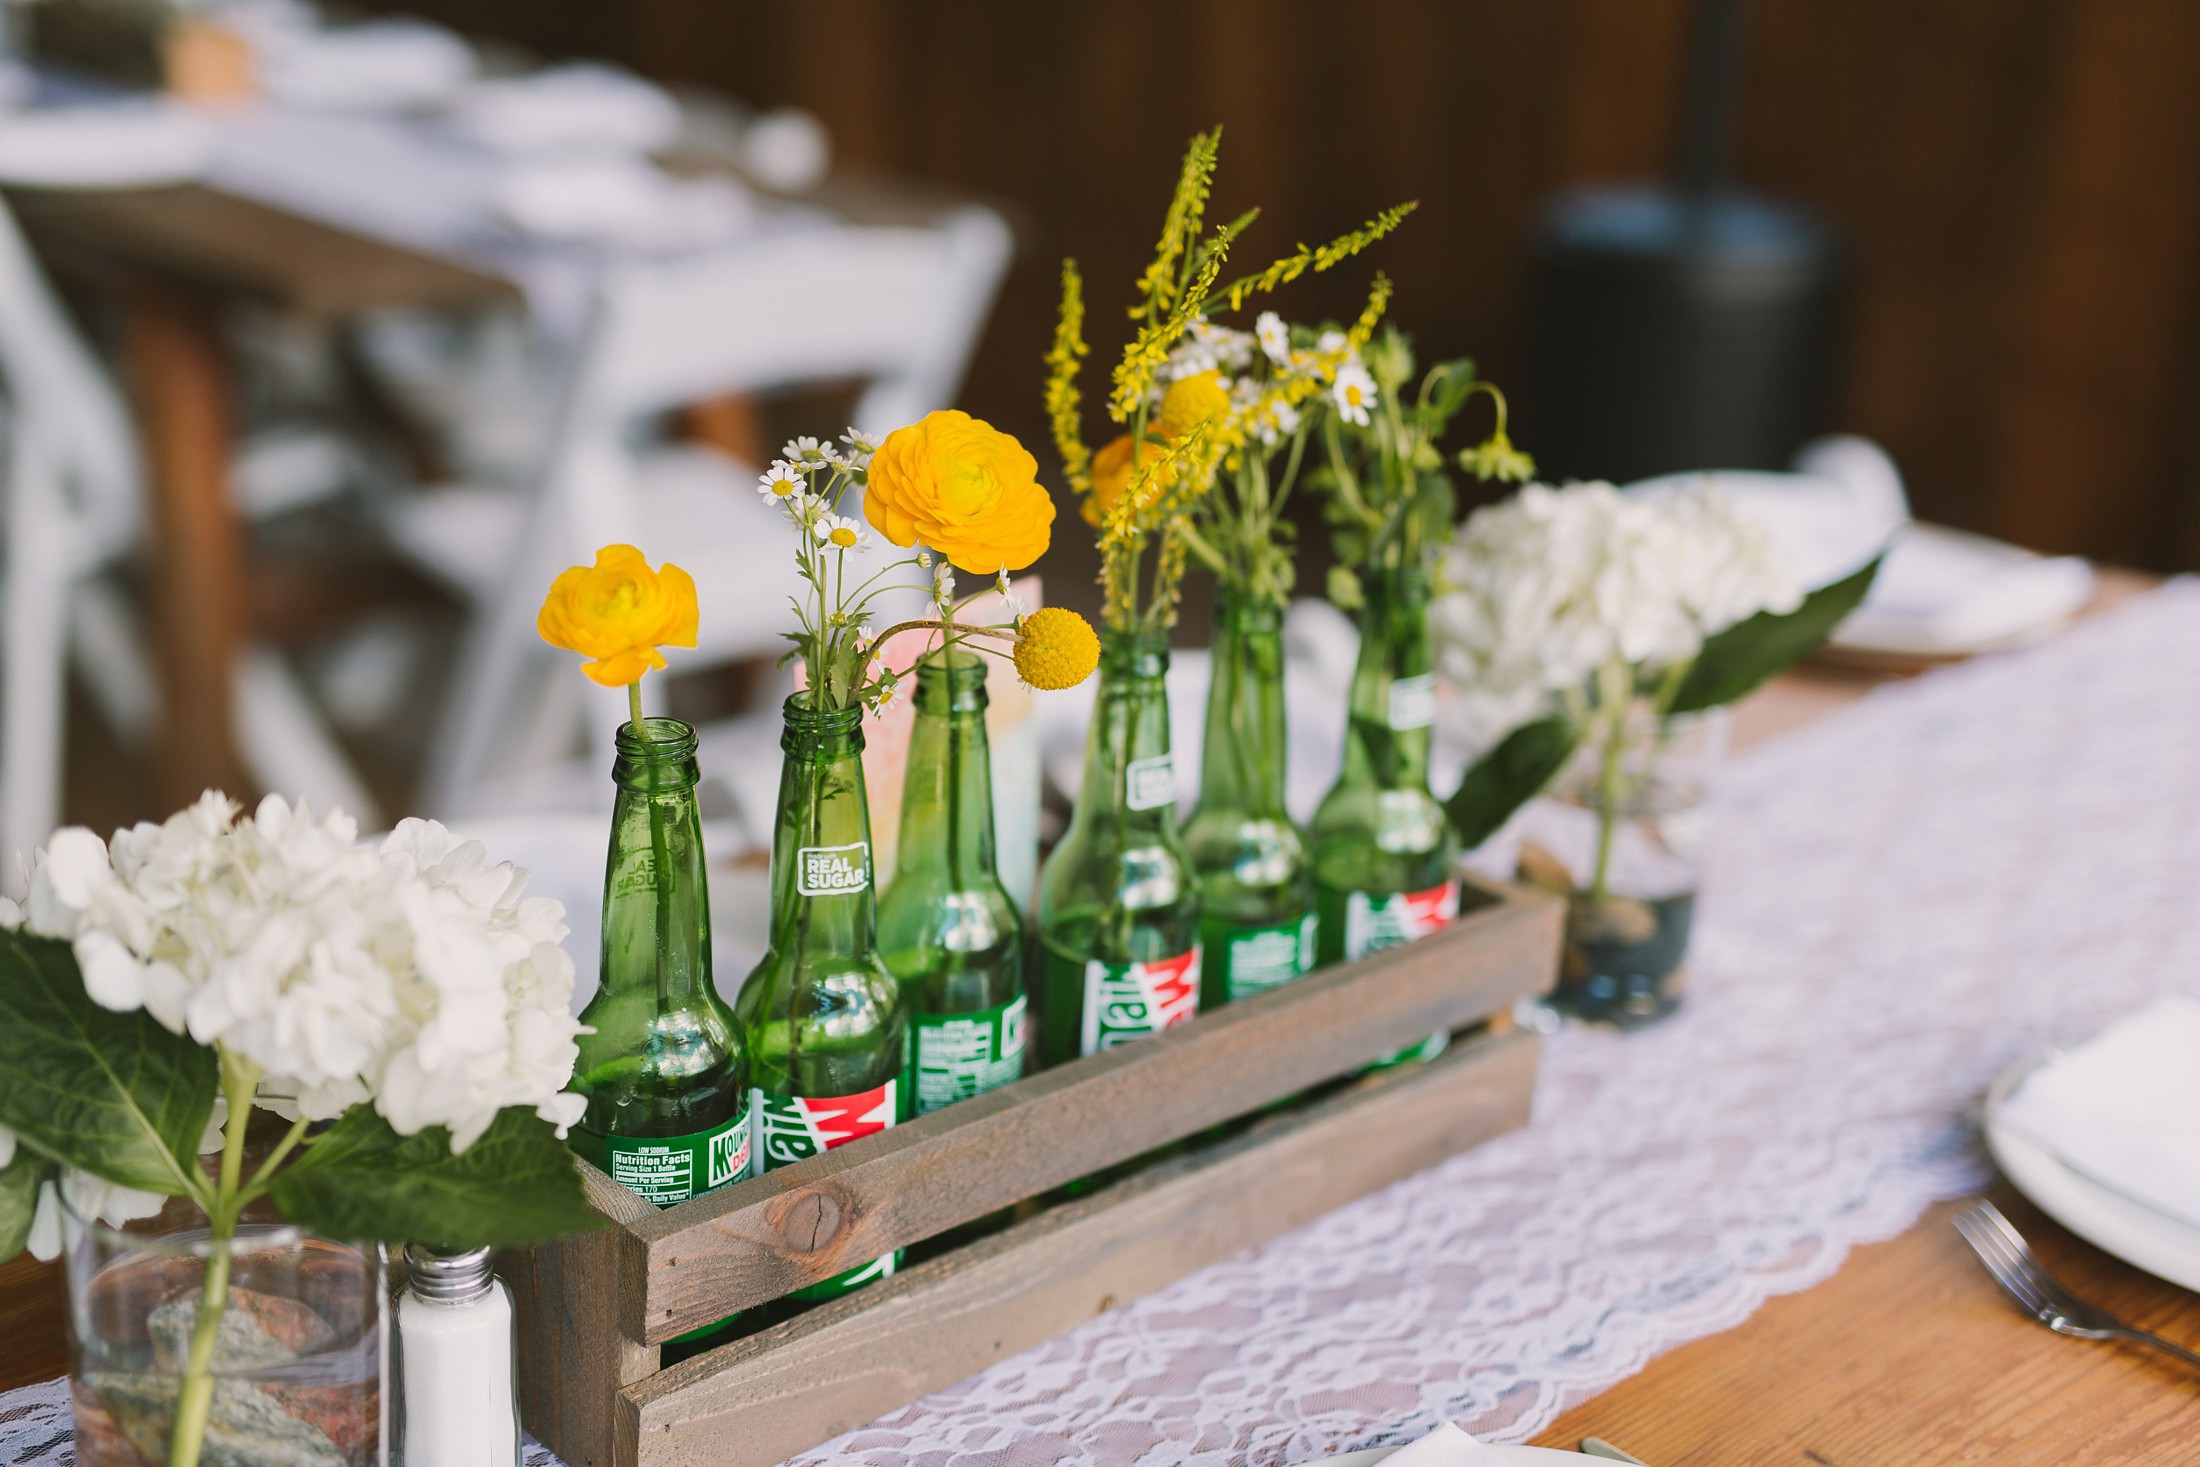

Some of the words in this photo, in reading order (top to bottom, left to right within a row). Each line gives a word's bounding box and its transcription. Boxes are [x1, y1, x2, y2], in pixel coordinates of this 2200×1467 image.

[807, 857, 852, 874] REAL
[807, 868, 865, 888] SUGAR
[615, 1154, 660, 1166] Nutrition
[662, 1154, 690, 1165] Facts
[615, 1163, 638, 1173] Serving
[657, 1164, 676, 1172] Bottle
[616, 1174, 638, 1183] Amount
[650, 1175, 674, 1184] Serving
[645, 1185, 658, 1193] 170
[652, 1195, 668, 1203] Daily
